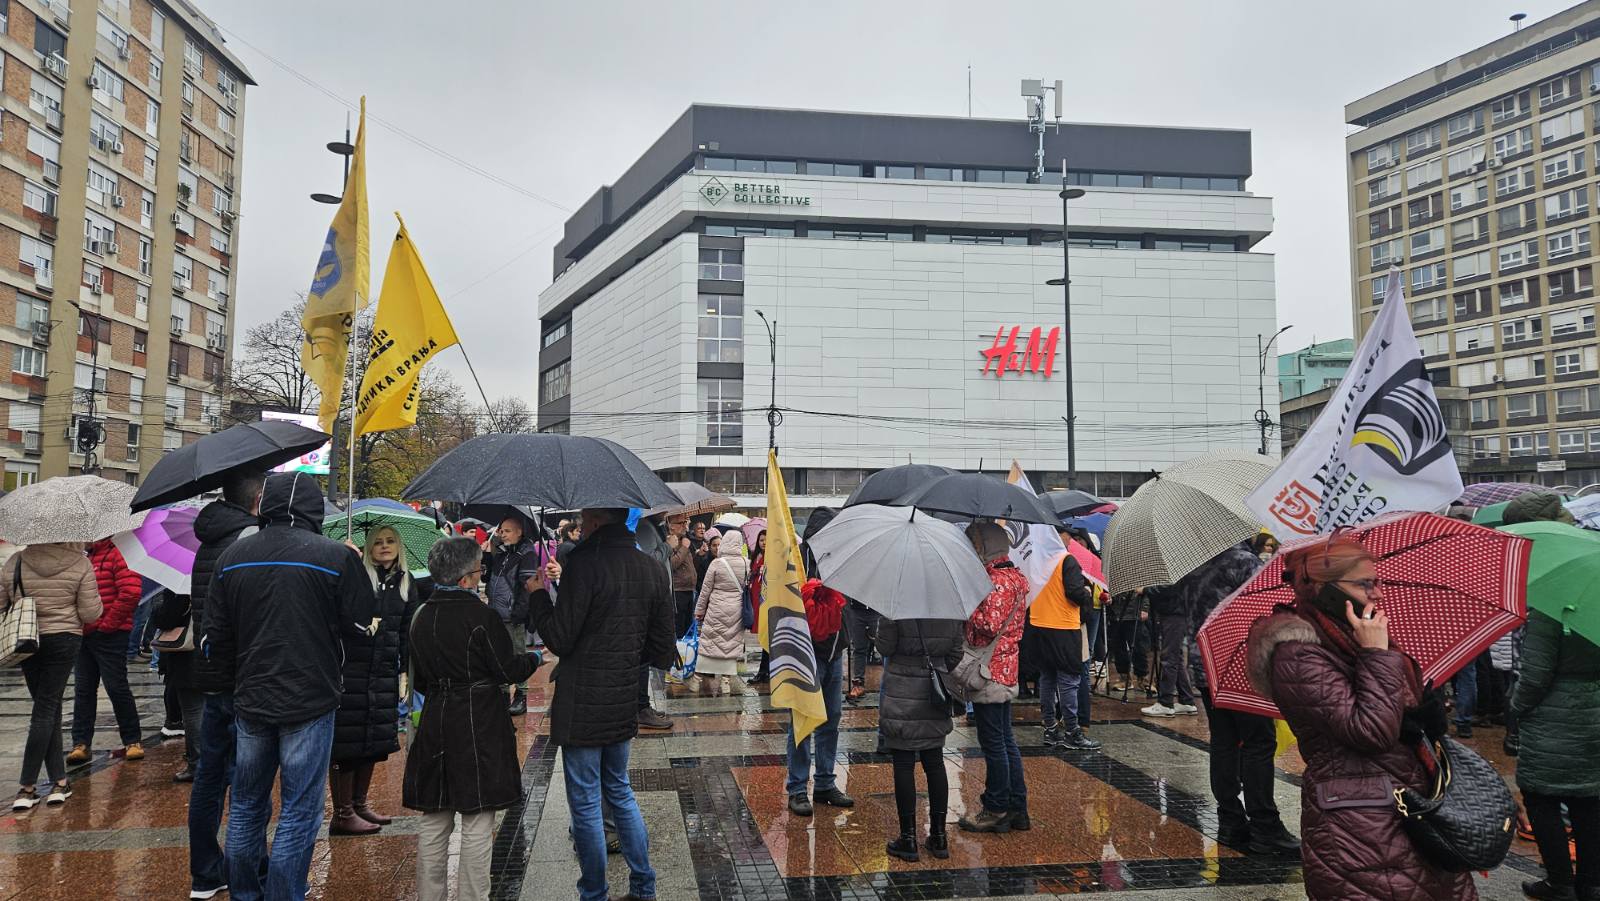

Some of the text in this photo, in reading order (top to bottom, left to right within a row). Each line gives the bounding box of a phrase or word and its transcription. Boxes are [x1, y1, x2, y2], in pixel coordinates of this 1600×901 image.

[734, 183, 780, 194] BETTER
[734, 194, 811, 206] COLLECTIVE
[979, 326, 1060, 378] H&M
[355, 337, 438, 416] АДНИКА ВРАЊА
